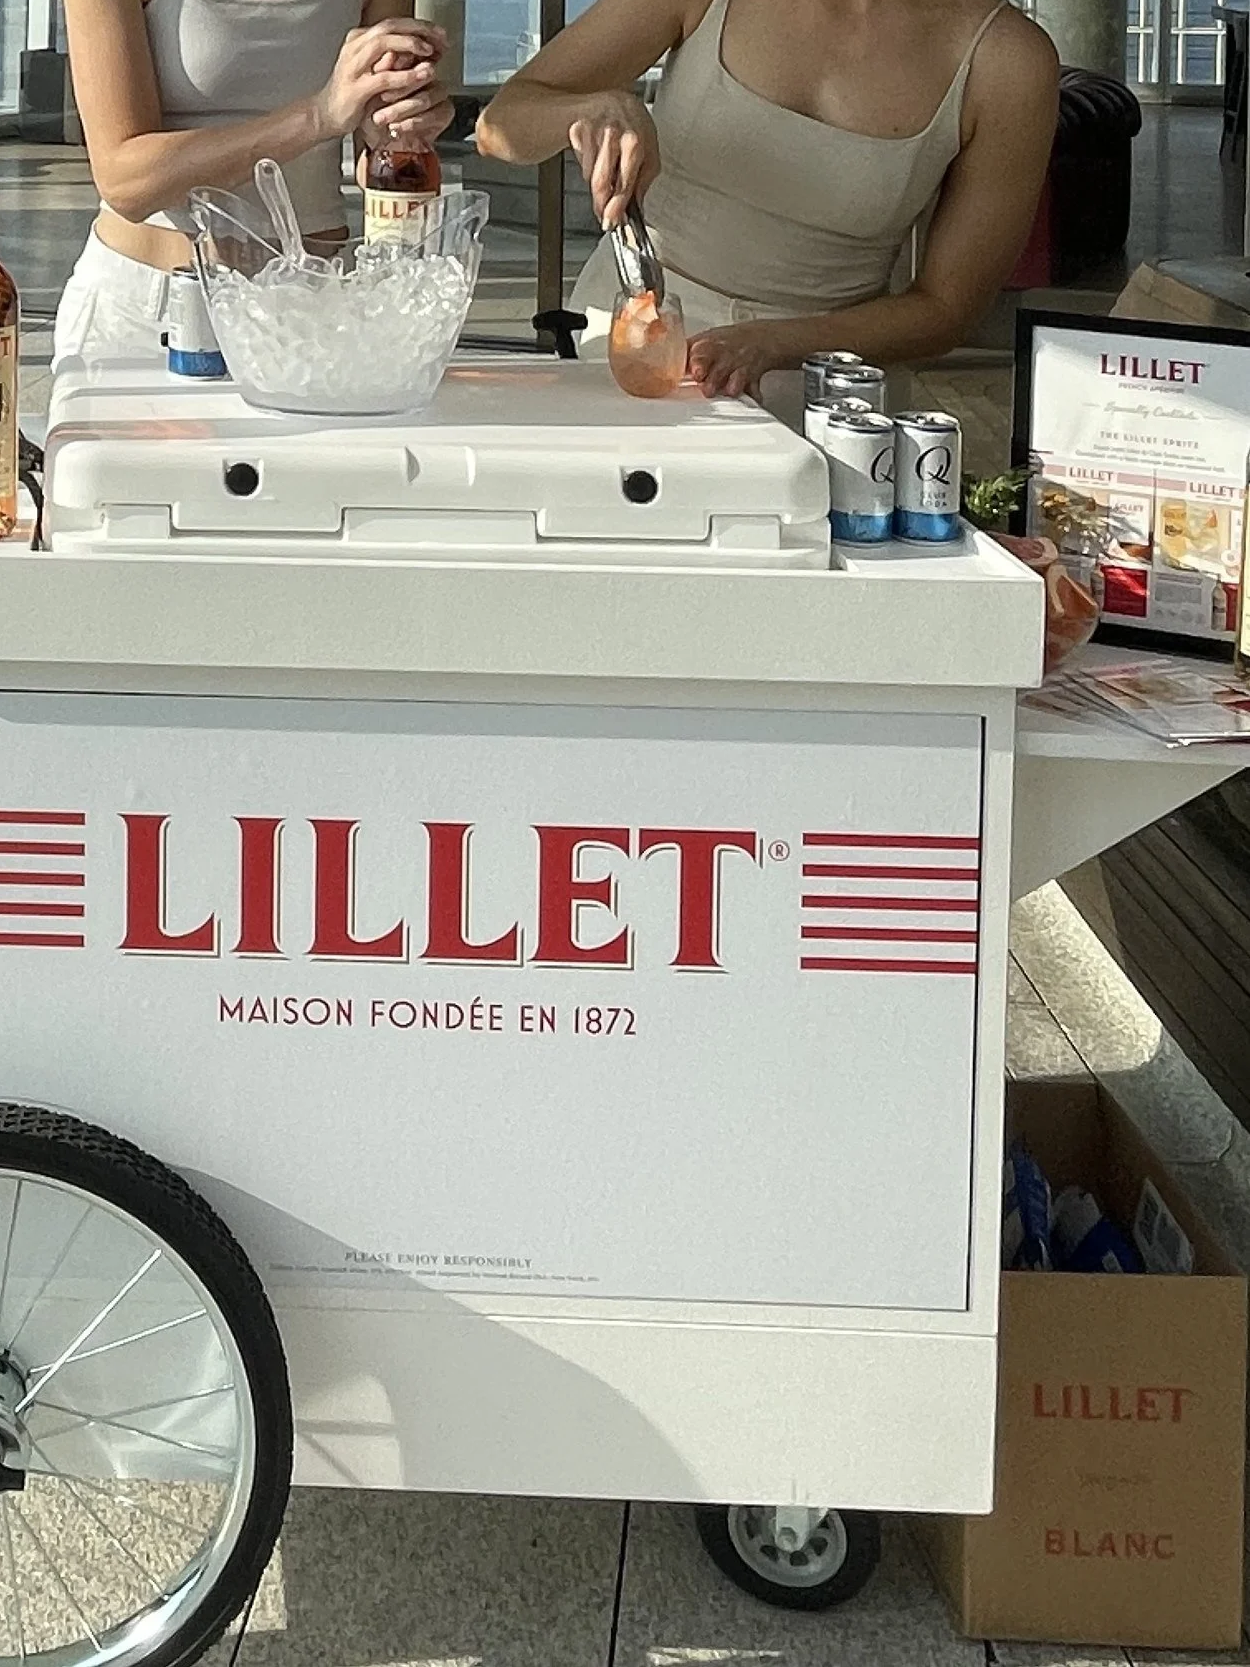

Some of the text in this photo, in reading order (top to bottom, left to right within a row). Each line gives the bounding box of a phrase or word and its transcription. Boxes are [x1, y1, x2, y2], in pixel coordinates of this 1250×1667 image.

[1101, 353, 1207, 384] LILLET
[915, 445, 950, 485] Q
[1069, 466, 1114, 482] LILLET
[1189, 482, 1235, 498] LILLET
[217, 994, 638, 1036] MAISON FONDÉE EN 1872
[344, 1251, 533, 1269] PLEASE ENJOY RESPONSIBLY
[1033, 1383, 1192, 1423] LILLET
[1045, 1528, 1176, 1560] BLANC
